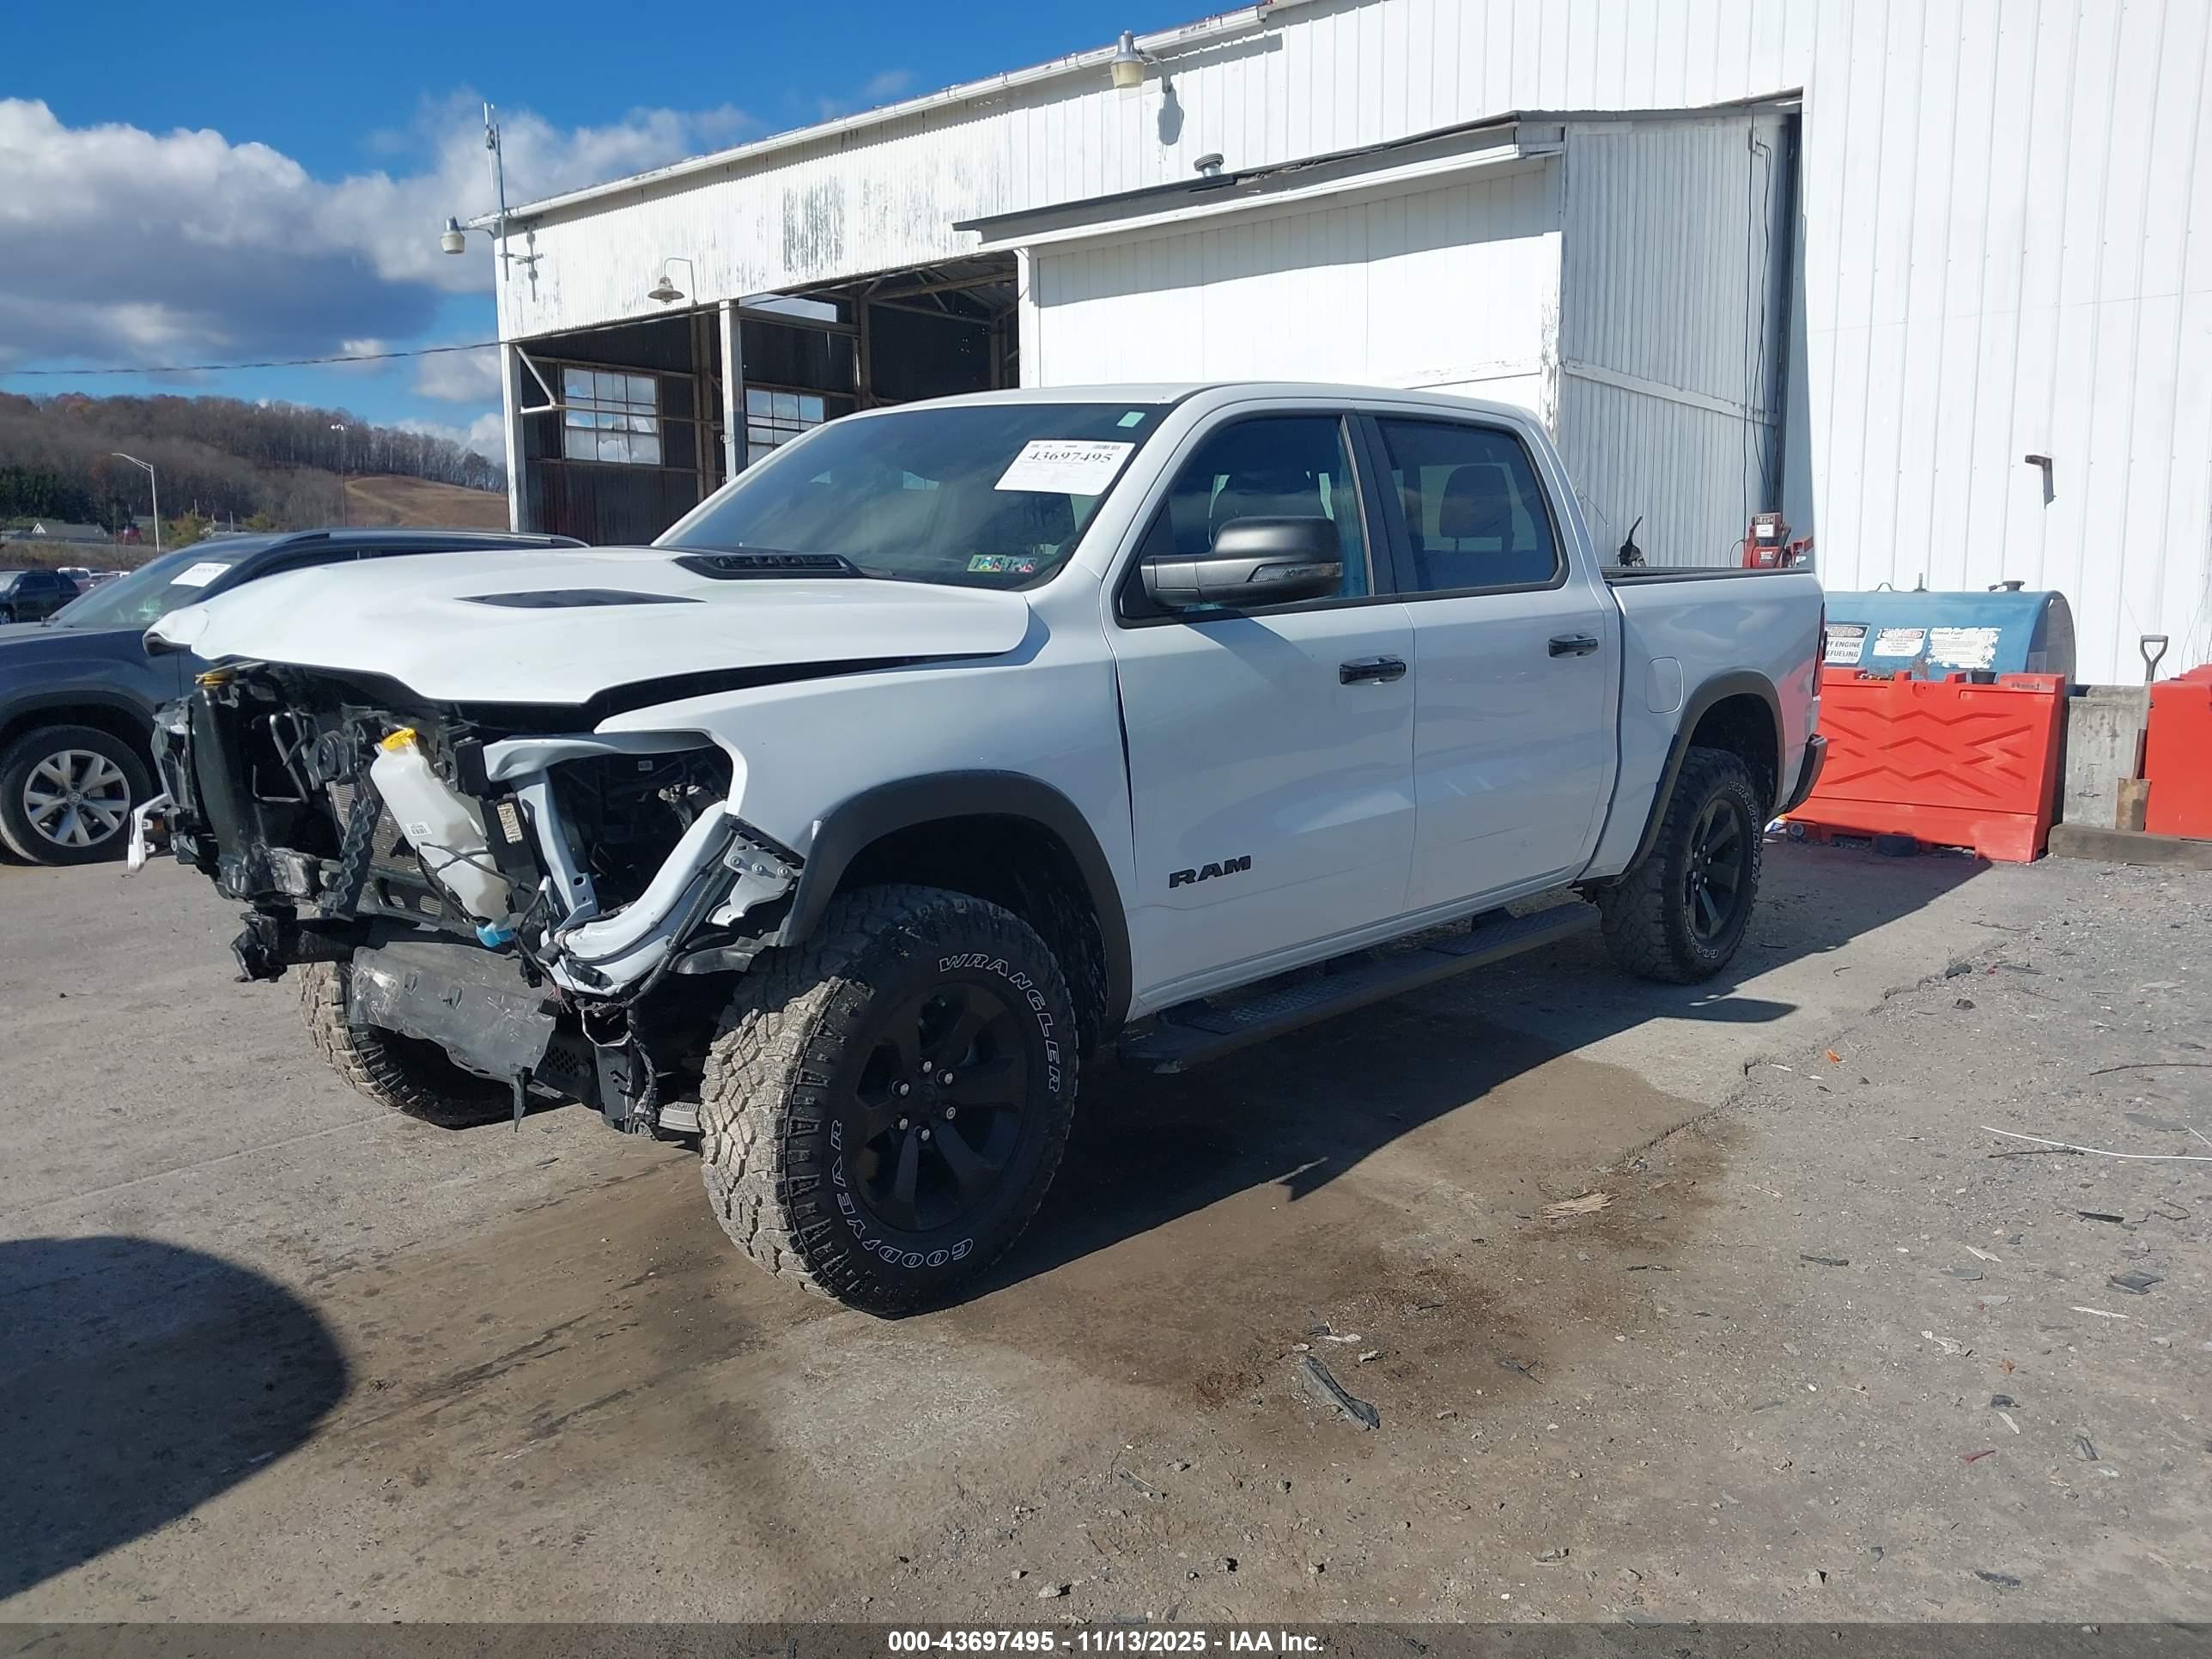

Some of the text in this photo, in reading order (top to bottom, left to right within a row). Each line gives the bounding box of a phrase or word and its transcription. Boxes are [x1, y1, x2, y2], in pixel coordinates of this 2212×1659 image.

[1028, 451, 1114, 463] 43697495
[1826, 649, 1859, 658] EFUELING
[1169, 854, 1251, 889] RAM
[939, 953, 1060, 1093] WRANGLER
[830, 1119, 974, 1268] GOODYEAR
